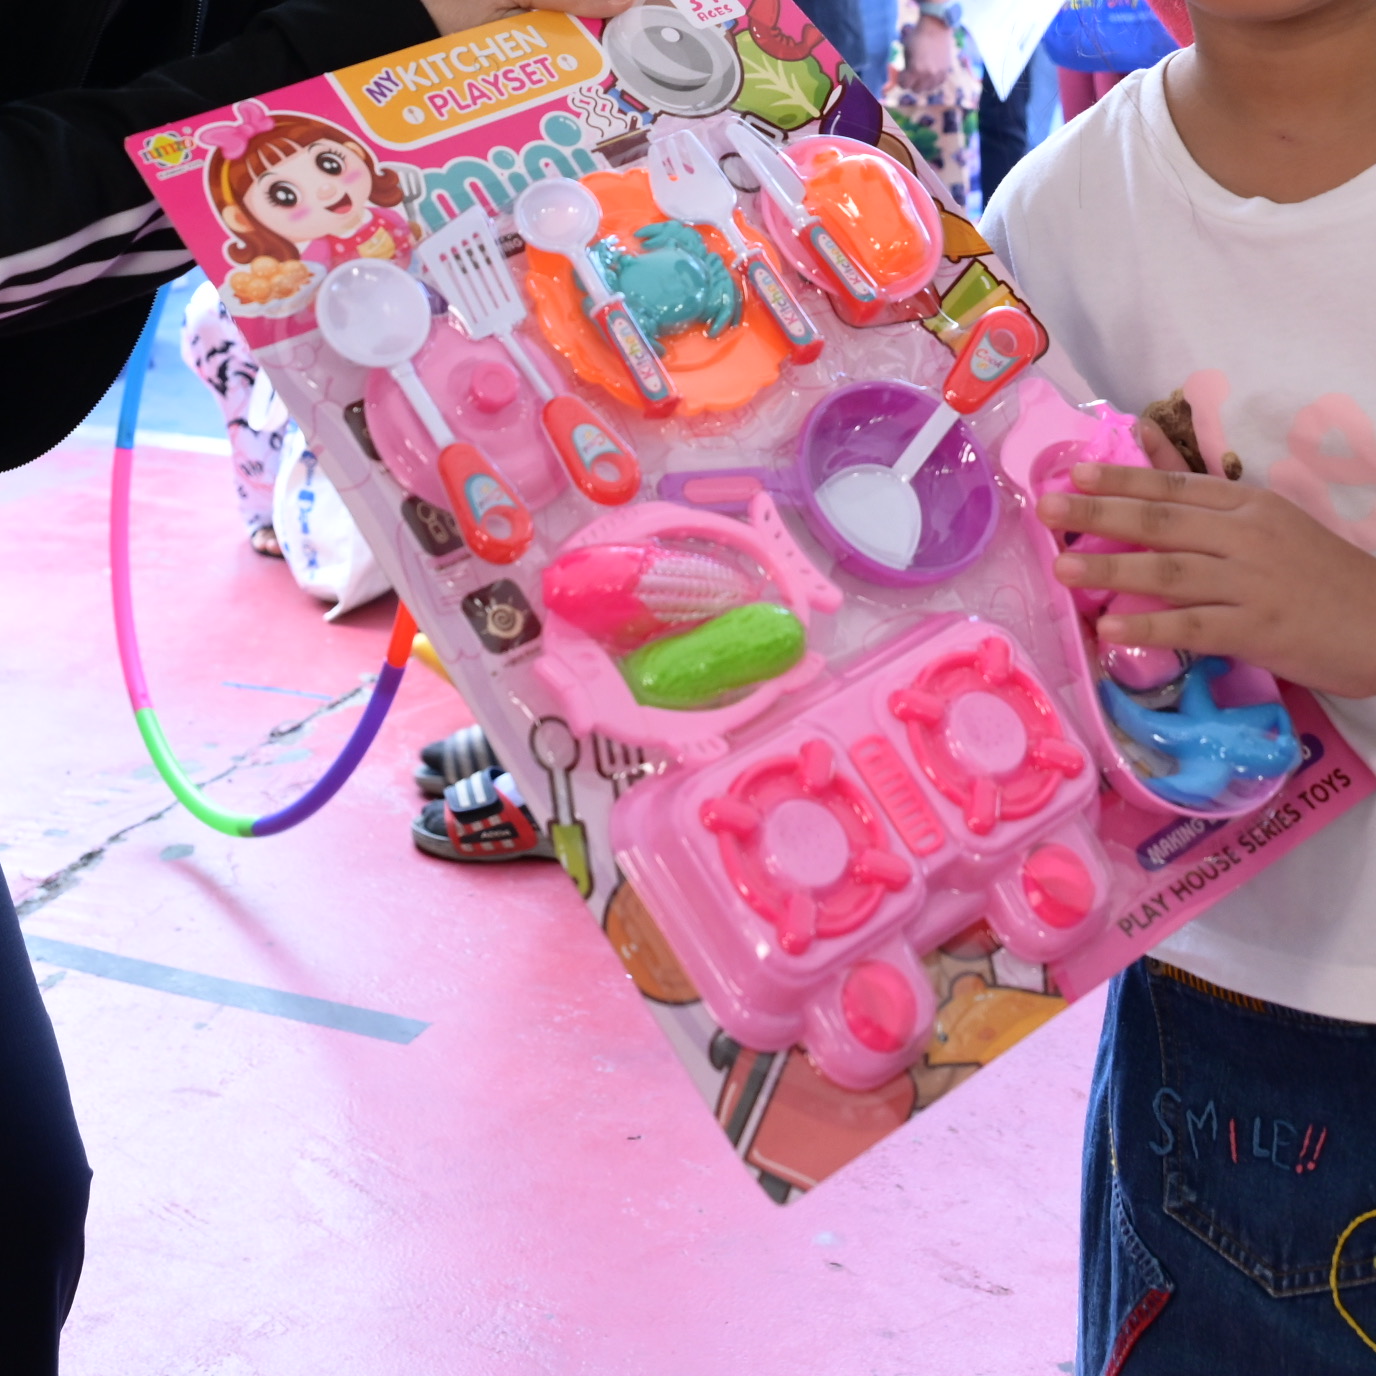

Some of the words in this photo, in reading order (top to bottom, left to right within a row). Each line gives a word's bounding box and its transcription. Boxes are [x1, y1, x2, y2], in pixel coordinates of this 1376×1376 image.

[696, 4, 734, 23] AGES
[364, 70, 401, 105] MY
[396, 24, 549, 92] KITCHEN
[426, 55, 560, 119] PLAYSET
[1118, 893, 1172, 939] PLAY
[1169, 845, 1243, 903] HOUSE
[1238, 802, 1303, 856] SERIES
[1298, 767, 1352, 811] TOYS
